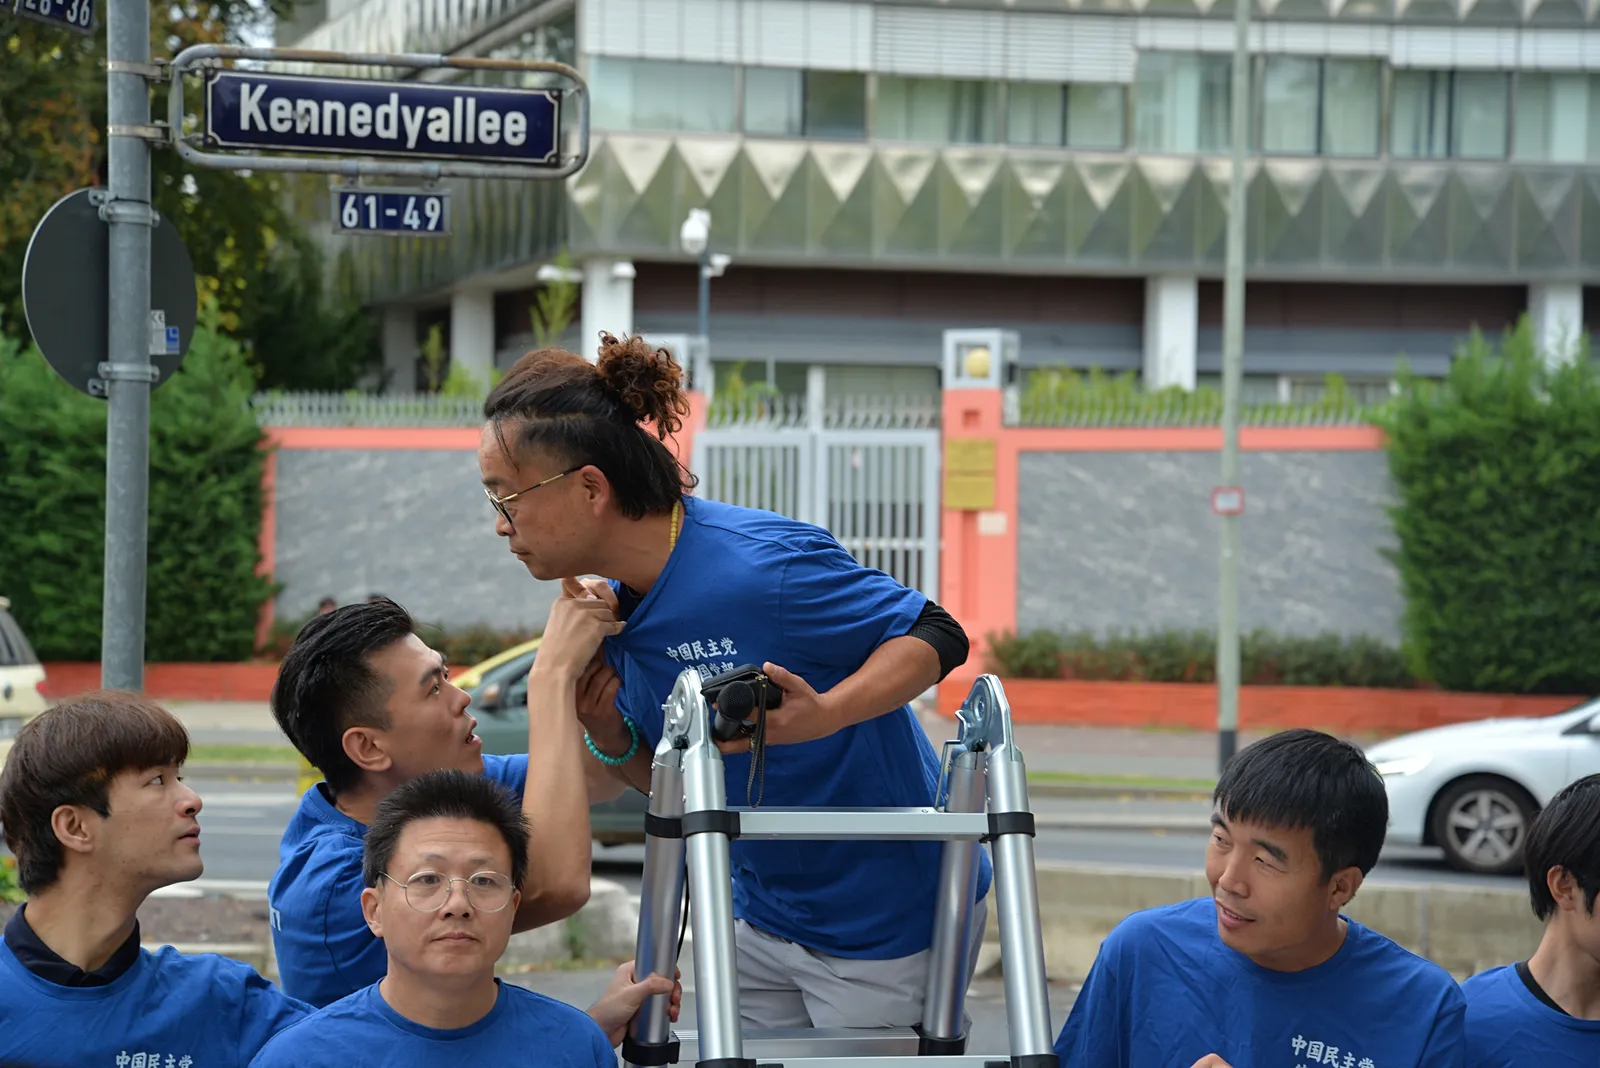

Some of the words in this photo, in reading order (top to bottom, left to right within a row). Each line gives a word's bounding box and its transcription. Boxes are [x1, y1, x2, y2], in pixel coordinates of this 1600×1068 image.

[240, 82, 528, 149] Kennedyallee
[342, 194, 441, 231] 61-49
[666, 637, 738, 662] 中国民主党
[684, 661, 735, 683] 国党部
